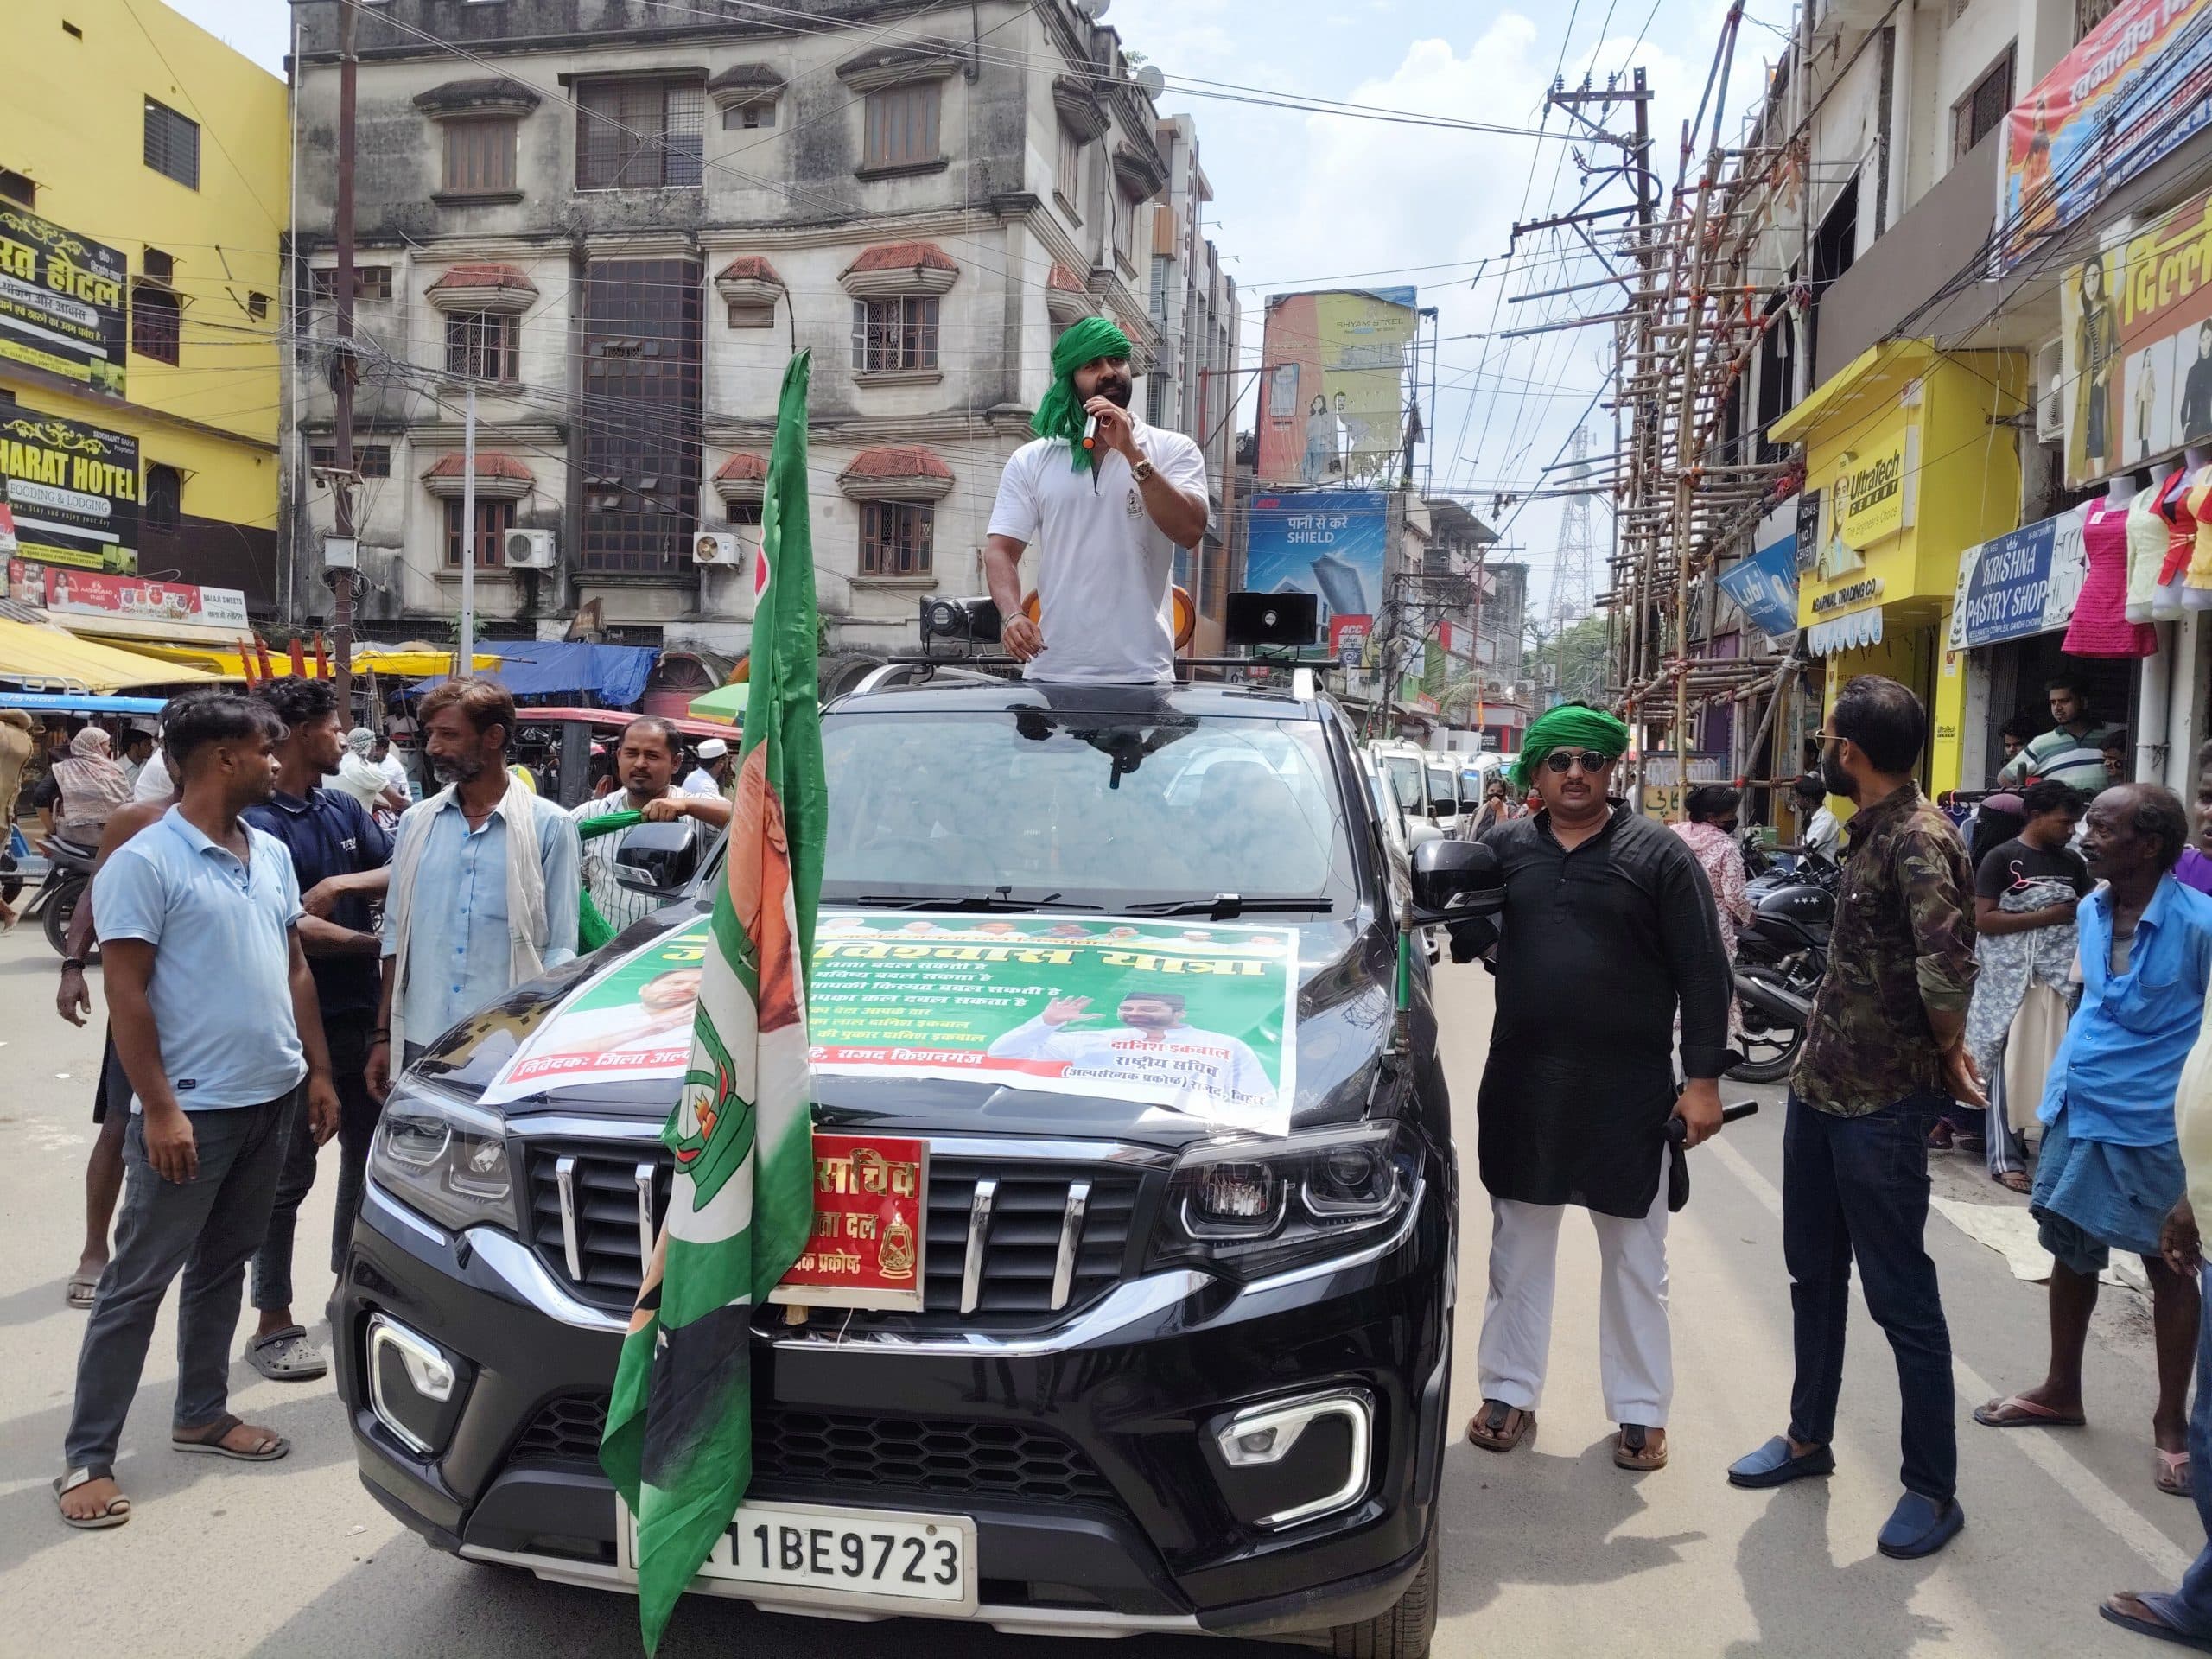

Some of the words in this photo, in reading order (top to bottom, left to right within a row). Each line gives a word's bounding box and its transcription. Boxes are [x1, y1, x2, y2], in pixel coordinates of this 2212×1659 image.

[46, 247, 121, 312] होटल
[55, 300, 86, 321] आवास
[1336, 320, 1370, 329] SHYAM
[1372, 318, 1403, 327] STEEL
[73, 456, 136, 502] HOTEL
[1850, 449, 1900, 500] UltraTech
[10, 483, 55, 503] FOODING
[57, 493, 65, 504] &
[67, 495, 109, 513] LODGING
[1850, 480, 1898, 516] CEMENT
[1287, 513, 1313, 530] पानी
[1315, 514, 1326, 530] से
[1287, 531, 1335, 543] SHIELD
[1982, 543, 2037, 587] KRISHNA
[1731, 570, 1765, 607] Lubi
[1839, 582, 1866, 605] TRADING
[1866, 578, 1876, 595] CO
[1966, 588, 2012, 630] PASTRY
[2011, 580, 2048, 617] SHOP
[1339, 625, 1363, 634] ACC
[1097, 950, 1273, 976] यात्रा
[594, 1052, 649, 1066] जिला
[836, 1048, 888, 1061] राजद
[889, 1047, 985, 1065] किशनगंज
[1110, 1039, 1164, 1052] दानिश
[1115, 1055, 1168, 1071] राष्ट्रीय
[1172, 1059, 1220, 1078] सचिव
[816, 1148, 920, 1198] सचिव
[845, 1212, 879, 1240] दल
[817, 1248, 861, 1274] प्रकोष्ठ
[706, 1522, 958, 1586] 11BE9723
